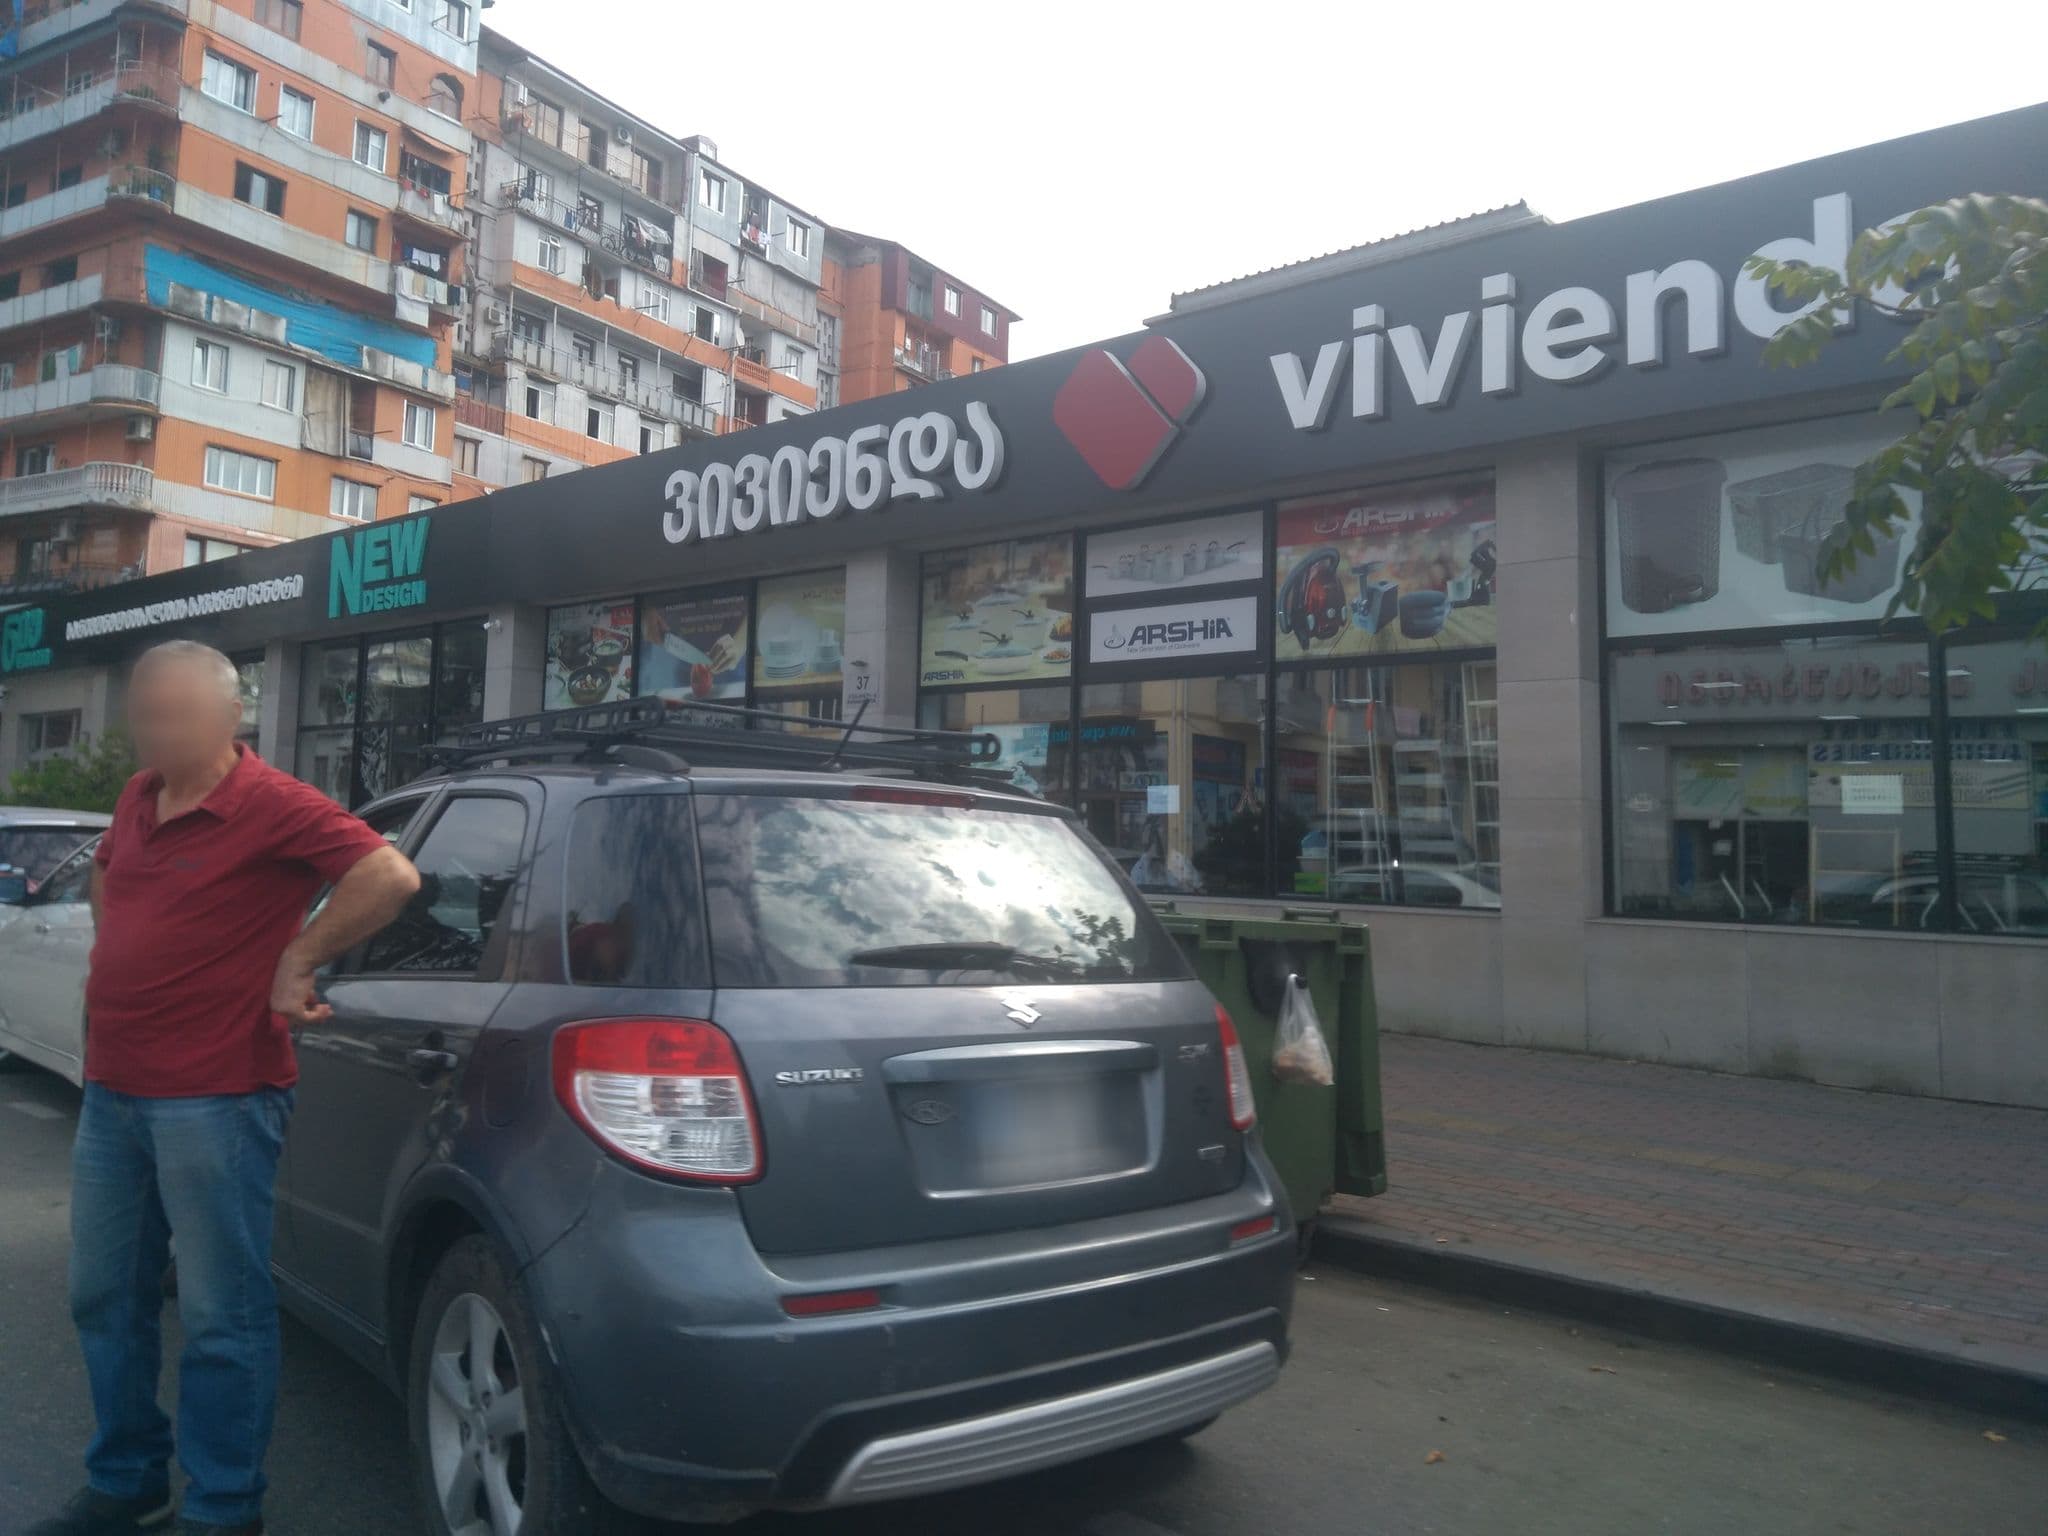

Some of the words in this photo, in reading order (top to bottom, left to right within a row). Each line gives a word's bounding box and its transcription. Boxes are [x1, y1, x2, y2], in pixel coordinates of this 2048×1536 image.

[662, 400, 1006, 545] ვივიენდა
[328, 516, 431, 620] NEW
[362, 580, 427, 613] DESIGN
[856, 675, 870, 690] 37
[775, 1067, 865, 1086] SUZUKI
